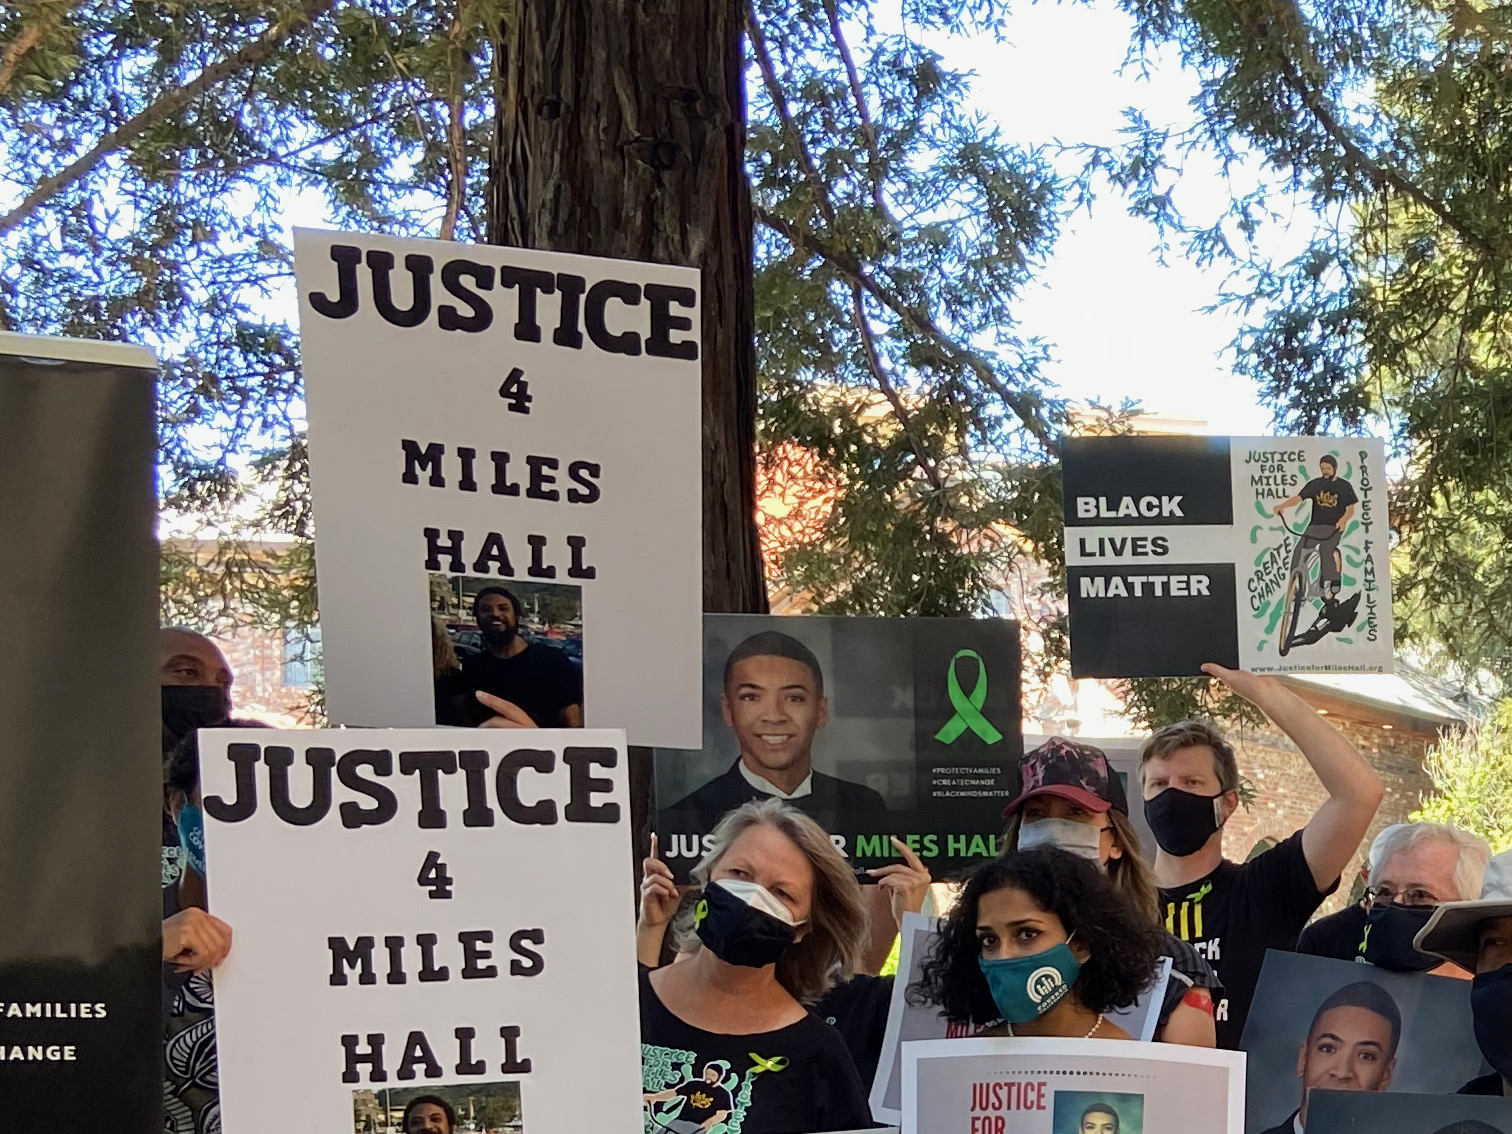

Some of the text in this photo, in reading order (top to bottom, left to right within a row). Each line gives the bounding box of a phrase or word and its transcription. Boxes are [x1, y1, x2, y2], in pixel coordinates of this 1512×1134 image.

[309, 245, 699, 361] JUSTICE
[499, 368, 533, 414] 4
[401, 439, 602, 504] MILES
[1245, 449, 1307, 464] JUSTICE
[1260, 464, 1287, 474] FOR
[1250, 474, 1298, 488] MILES
[1255, 487, 1290, 500] HALL
[1076, 496, 1184, 519] BLACK
[424, 527, 597, 579] HALL
[1079, 536, 1170, 558] LIVES
[1248, 536, 1293, 593] CREATE
[1358, 450, 1379, 642] PROTECT FAMILIES
[1080, 574, 1212, 598] MATTER
[1250, 555, 1291, 612] CHANGE
[203, 743, 622, 829] JUSTICE
[665, 834, 718, 858] JUS
[855, 834, 940, 858] MILES
[947, 834, 1002, 858] HAL
[417, 851, 453, 899] 4
[328, 929, 545, 986] MILES
[341, 1026, 532, 1083] HALL
[641, 1043, 697, 1064] USTICE
[971, 1081, 1047, 1111] JUSTICE
